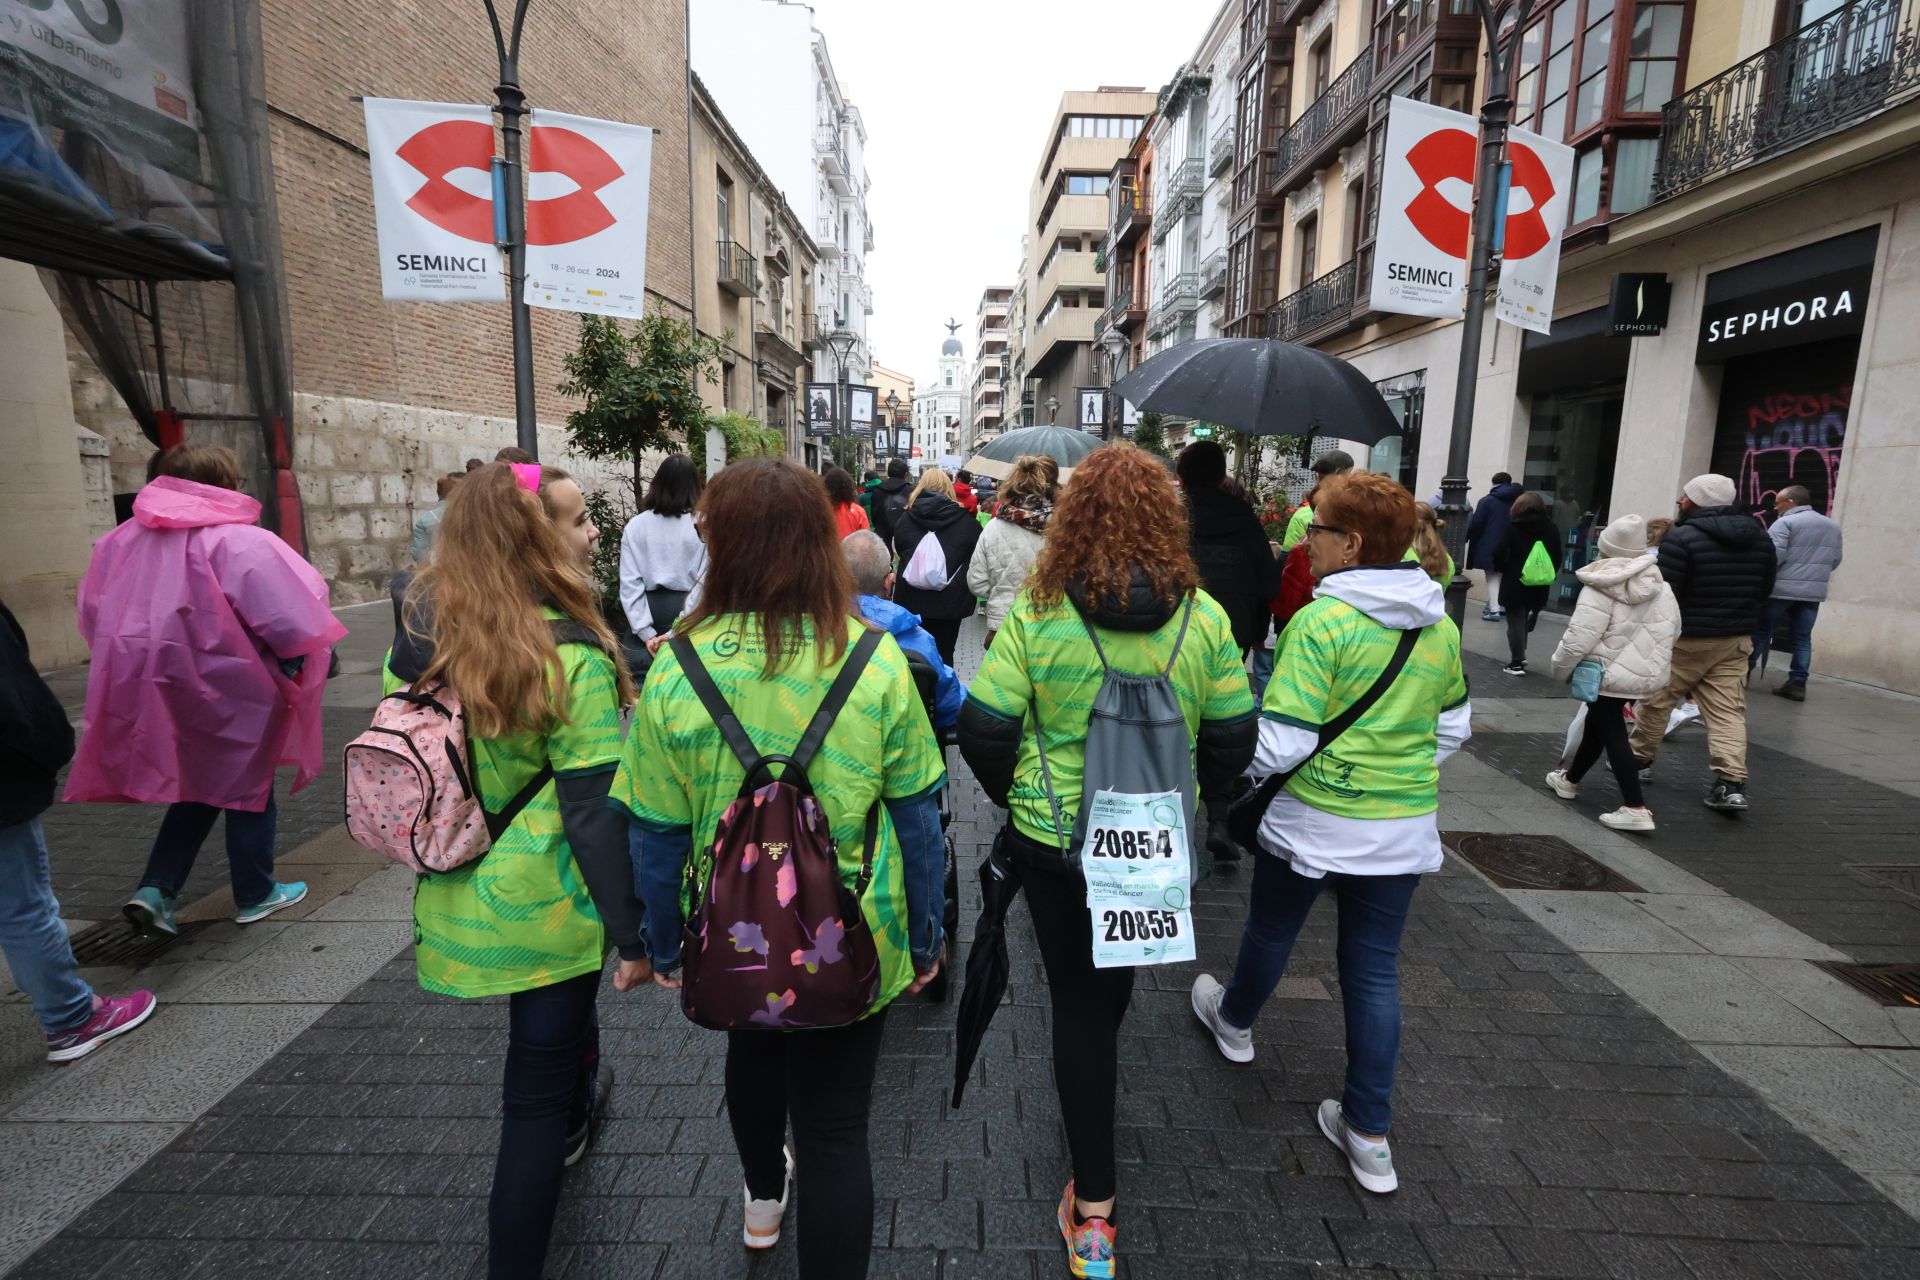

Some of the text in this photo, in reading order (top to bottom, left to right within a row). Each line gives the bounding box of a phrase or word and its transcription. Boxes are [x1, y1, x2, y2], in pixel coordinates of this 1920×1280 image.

[8, 14, 21, 34] y
[30, 23, 122, 80] urbanismo
[397, 254, 486, 272] SEMINCI
[551, 263, 559, 271] 18
[566, 265, 576, 273] 26
[596, 267, 620, 279] 2024
[1388, 262, 1453, 287] SEMINCI
[404, 276, 416, 286] 69
[1614, 323, 1658, 332] SEPHORA
[1707, 290, 1853, 343] SEPHORA
[1092, 828, 1173, 860] 20854
[1103, 909, 1179, 942] 20855
